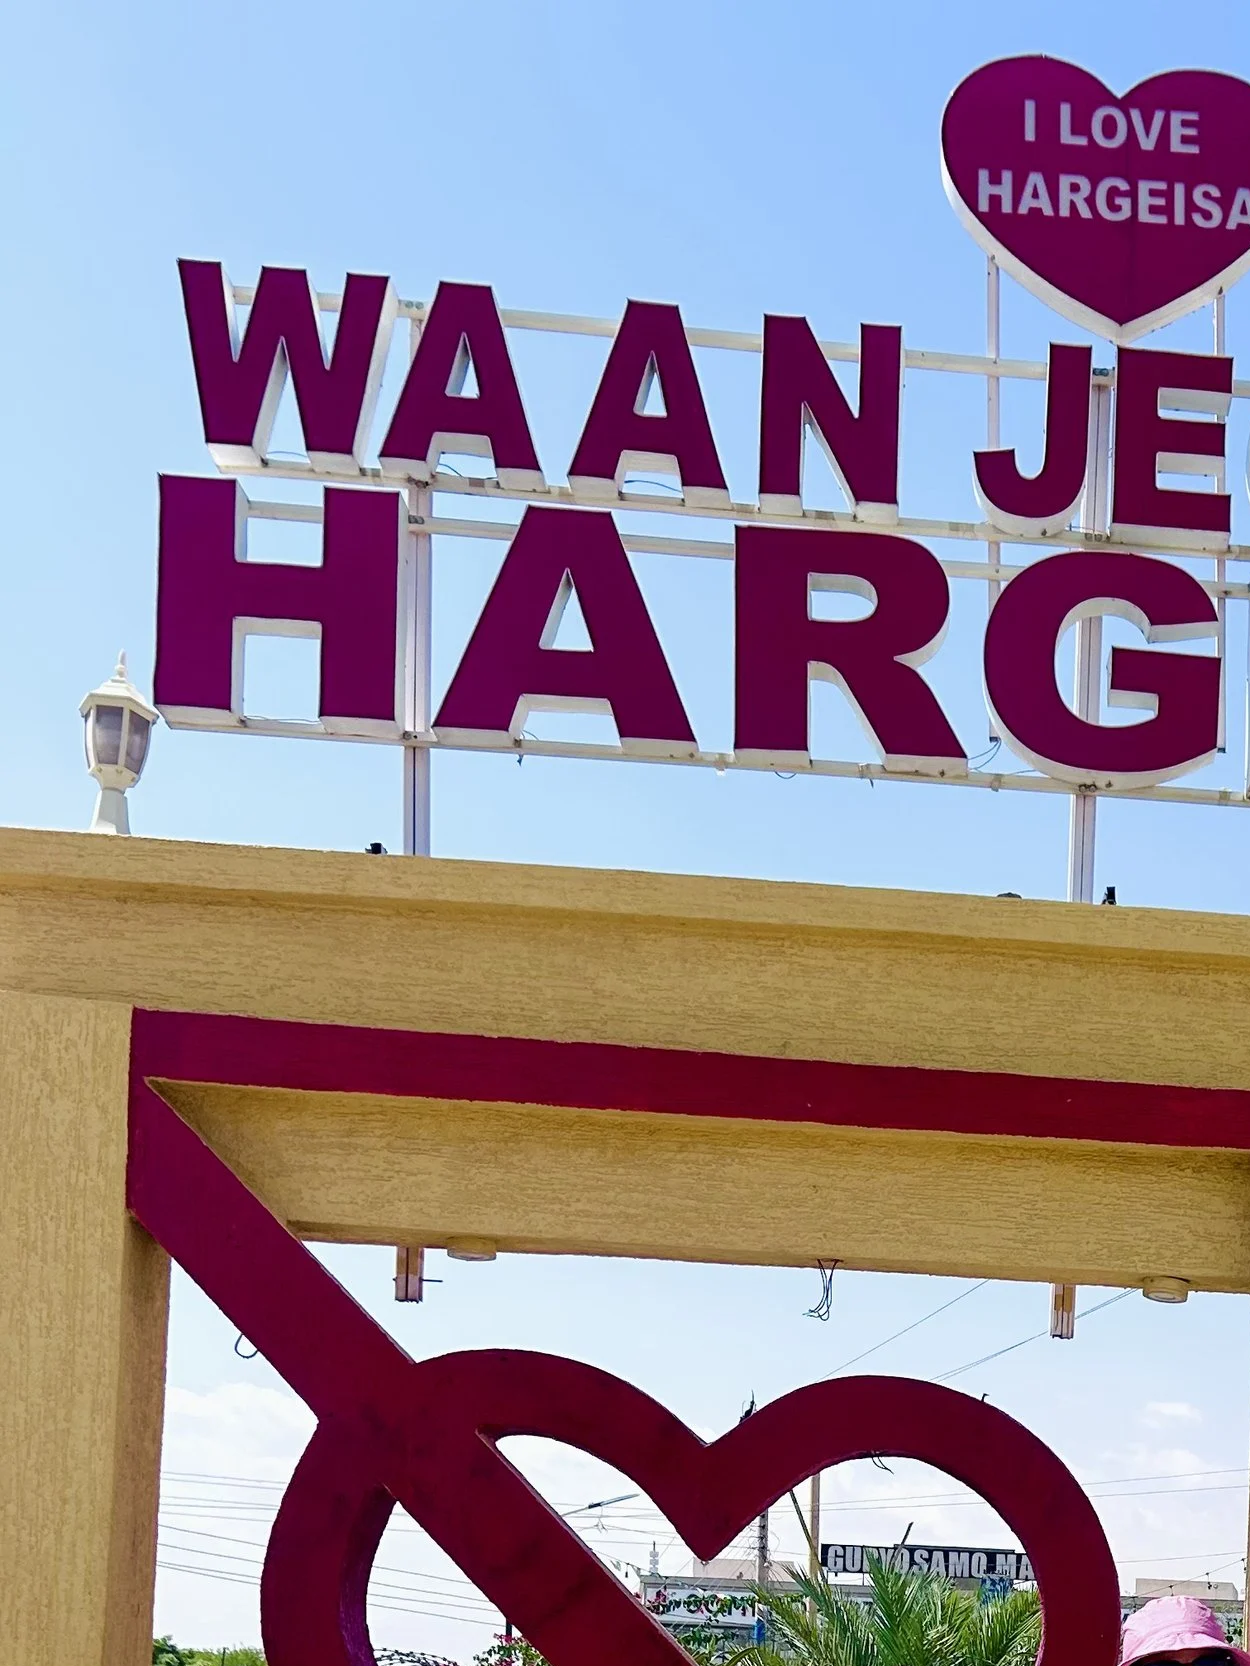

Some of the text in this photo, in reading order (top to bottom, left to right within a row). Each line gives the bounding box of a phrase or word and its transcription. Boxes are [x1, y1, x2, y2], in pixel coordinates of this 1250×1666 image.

[1023, 99, 1200, 154] I LOVE
[177, 258, 904, 520] WAAN
